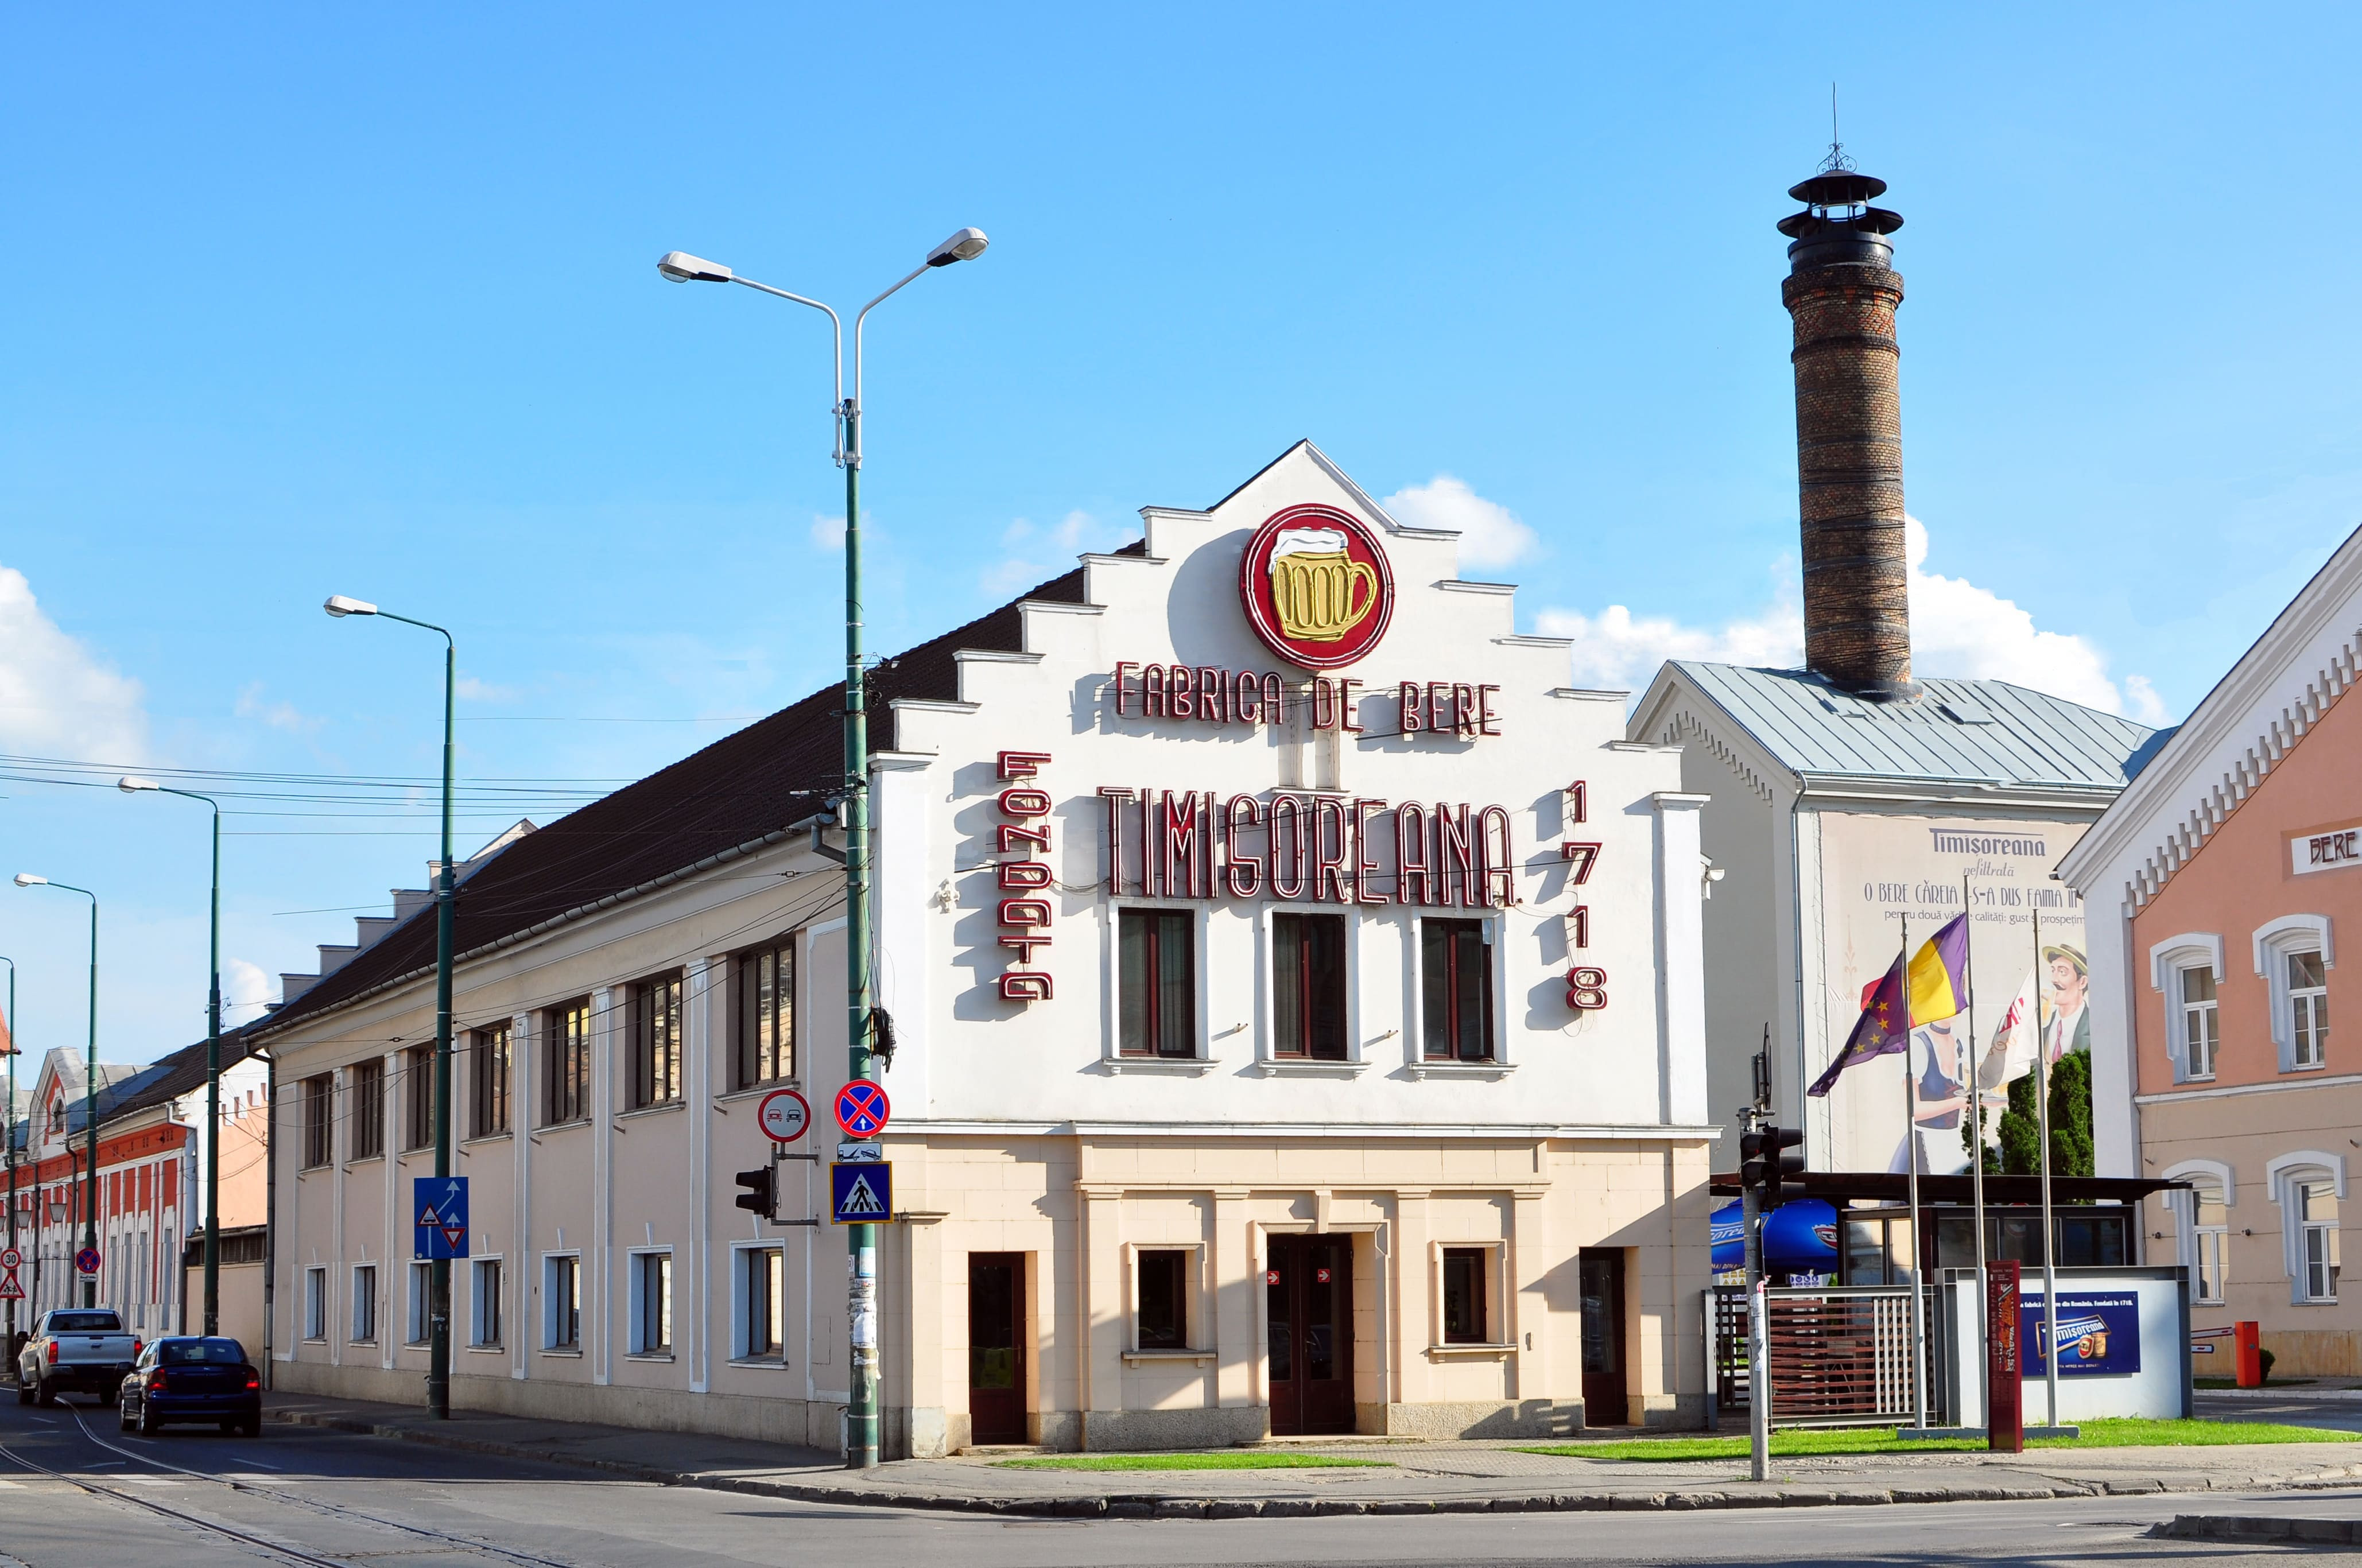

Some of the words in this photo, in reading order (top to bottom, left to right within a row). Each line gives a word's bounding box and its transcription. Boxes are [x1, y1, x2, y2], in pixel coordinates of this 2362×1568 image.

[1116, 661, 1284, 725] FABRICA
[1311, 675, 1364, 732] DE
[1399, 681, 1502, 736] BERE
[1097, 786, 1517, 908] TIMISOREANA
[2309, 831, 2359, 865] BERE
[996, 751, 1053, 1000] FONDATA
[1561, 780, 1608, 1010] 1718
[1864, 883, 1873, 902] O
[1878, 883, 1910, 903] BERE
[1915, 879, 1958, 905] CĂREIA
[2000, 887, 2021, 907] DUS
[2027, 888, 2063, 908] FAIMA
[1918, 910, 1942, 920] două
[2008, 915, 2029, 925] gust
[2041, 914, 2085, 926] prospețim
[6, 1254, 16, 1264] 30
